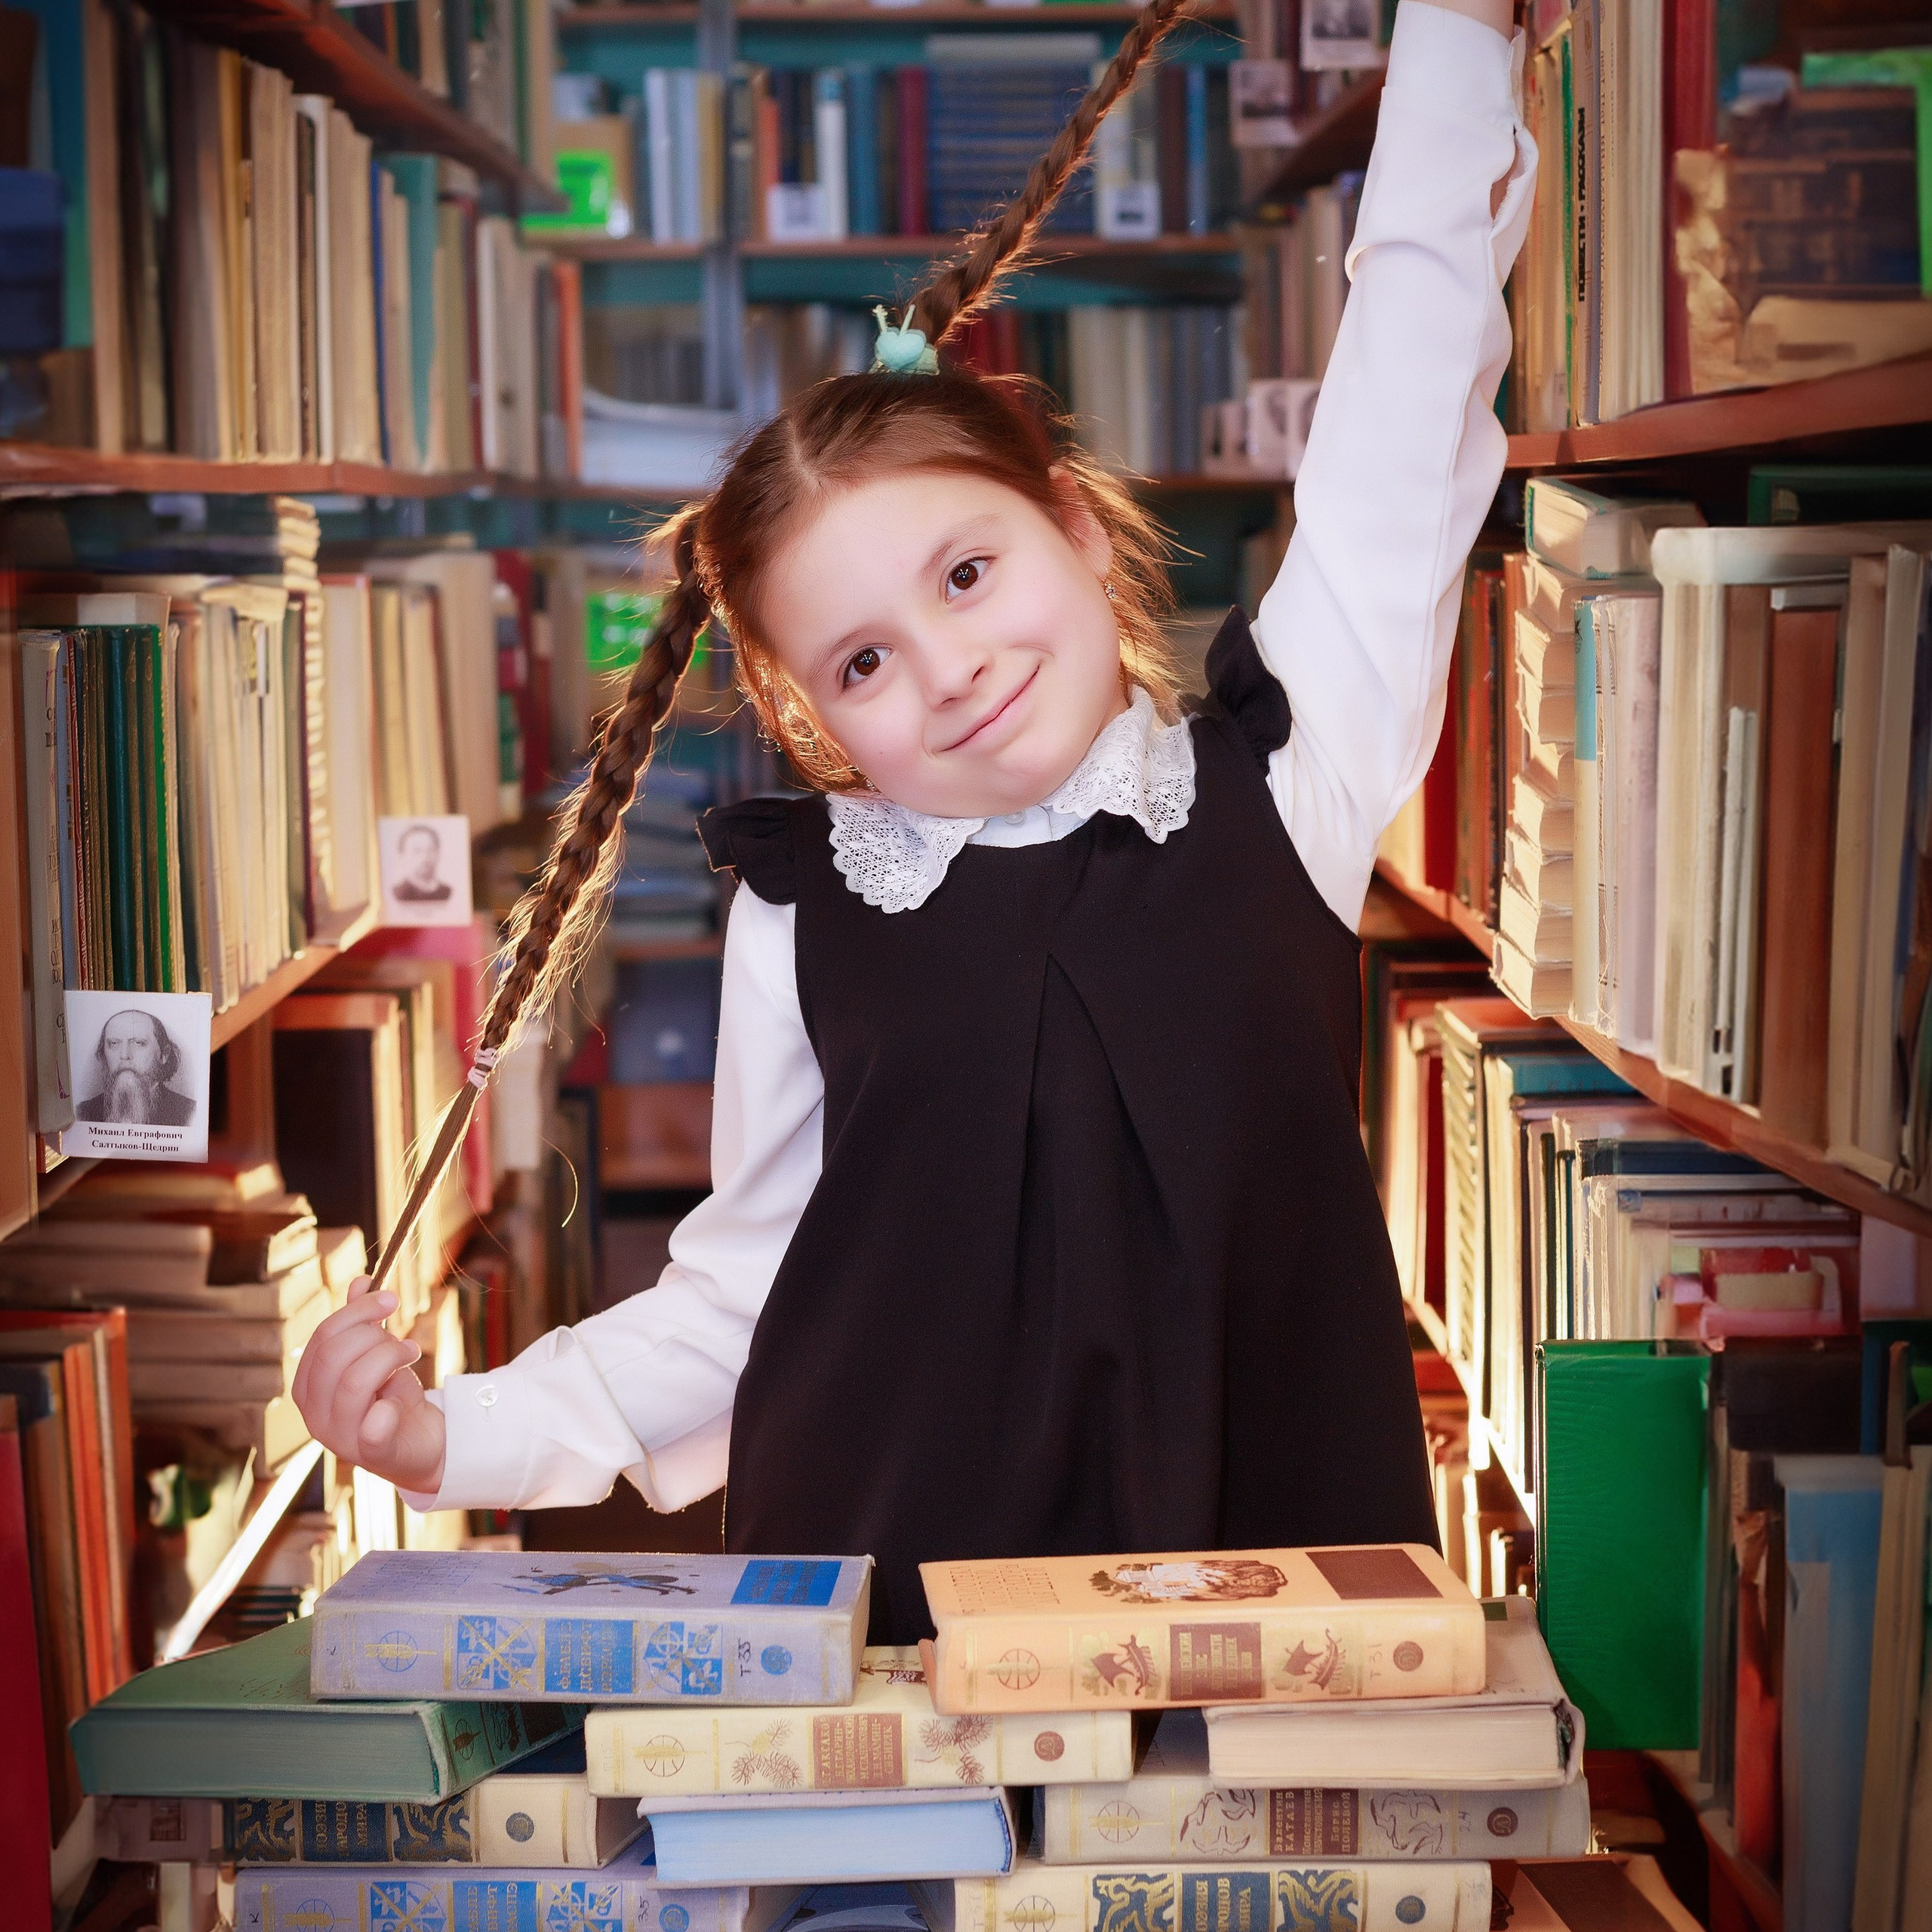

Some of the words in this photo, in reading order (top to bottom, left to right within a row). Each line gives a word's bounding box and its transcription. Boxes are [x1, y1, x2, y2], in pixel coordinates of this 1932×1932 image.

[1577, 107, 1586, 201] РАССКАЗЫ
[1577, 216, 1586, 302] ПОВЕСТИ
[88, 1126, 125, 1137] Михаил
[128, 1129, 183, 1140] Евграфович
[91, 1140, 180, 1153] Салтыков-Щедрин
[315, 1801, 328, 1854] ПОЭЗИ
[335, 1801, 349, 1857] НАРОДО
[1274, 1791, 1283, 1852] Валентин
[1285, 1791, 1294, 1852] КАТАЕВ
[1302, 1789, 1311, 1855] Константин
[1331, 1801, 1340, 1842] Борис
[1341, 1791, 1350, 1853] ПОЛЕВОЙ
[1196, 1880, 1208, 1932] ОЭЗИЯ
